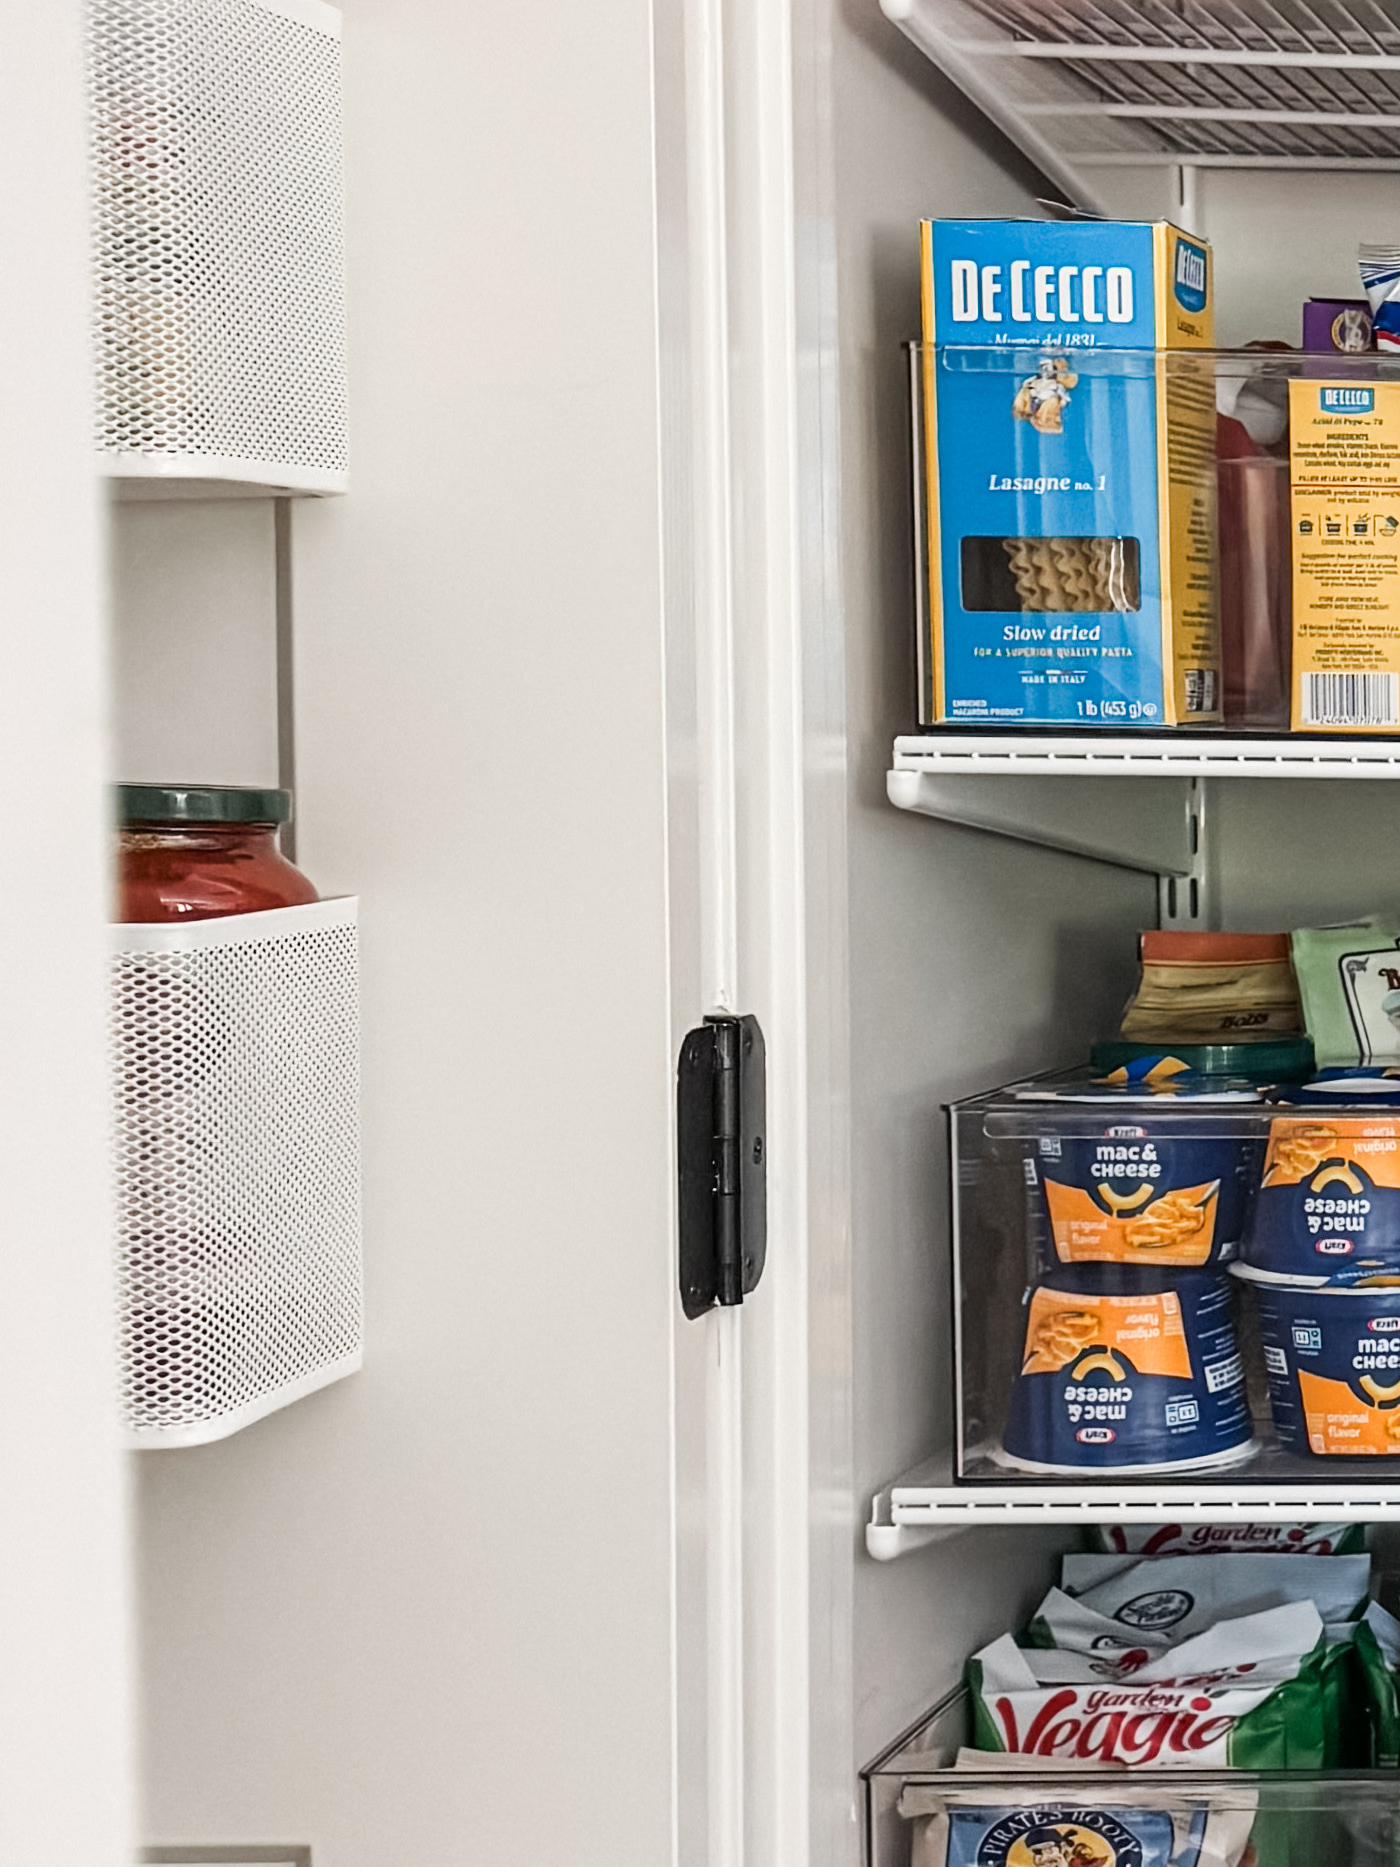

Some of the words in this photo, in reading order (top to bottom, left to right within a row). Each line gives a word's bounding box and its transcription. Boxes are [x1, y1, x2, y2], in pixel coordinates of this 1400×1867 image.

[952, 260, 1002, 322] DE
[1010, 260, 1133, 323] CECCO
[989, 475, 1070, 493] Lasagne
[1075, 480, 1093, 491] no.
[1098, 476, 1106, 491] 1
[1003, 625, 1046, 641] Slow
[1050, 625, 1100, 641] dried
[974, 647, 992, 657] FOR
[1006, 647, 1053, 657] SUPERIOR
[1056, 647, 1098, 659] QUALITY
[1101, 647, 1132, 657] PASTA
[1021, 675, 1045, 683] MADE
[1048, 675, 1058, 684] IN
[1060, 675, 1086, 684] ITALY
[1077, 701, 1084, 716] 1
[1086, 700, 1098, 716] lb
[1100, 700, 1126, 718] (453
[1129, 701, 1142, 719] g)
[1097, 1144, 1139, 1161] mac
[1142, 1144, 1157, 1161] &
[1307, 1217, 1324, 1235] &
[1325, 1217, 1365, 1232] mac
[1358, 1337, 1399, 1353] mac
[1068, 1405, 1085, 1423] &
[1087, 1405, 1126, 1420] mac
[1189, 1524, 1281, 1545] garden
[1086, 1690, 1185, 1713] garden
[997, 1690, 1237, 1767] Veggie
[1072, 1811, 1140, 1853] BOOTY
